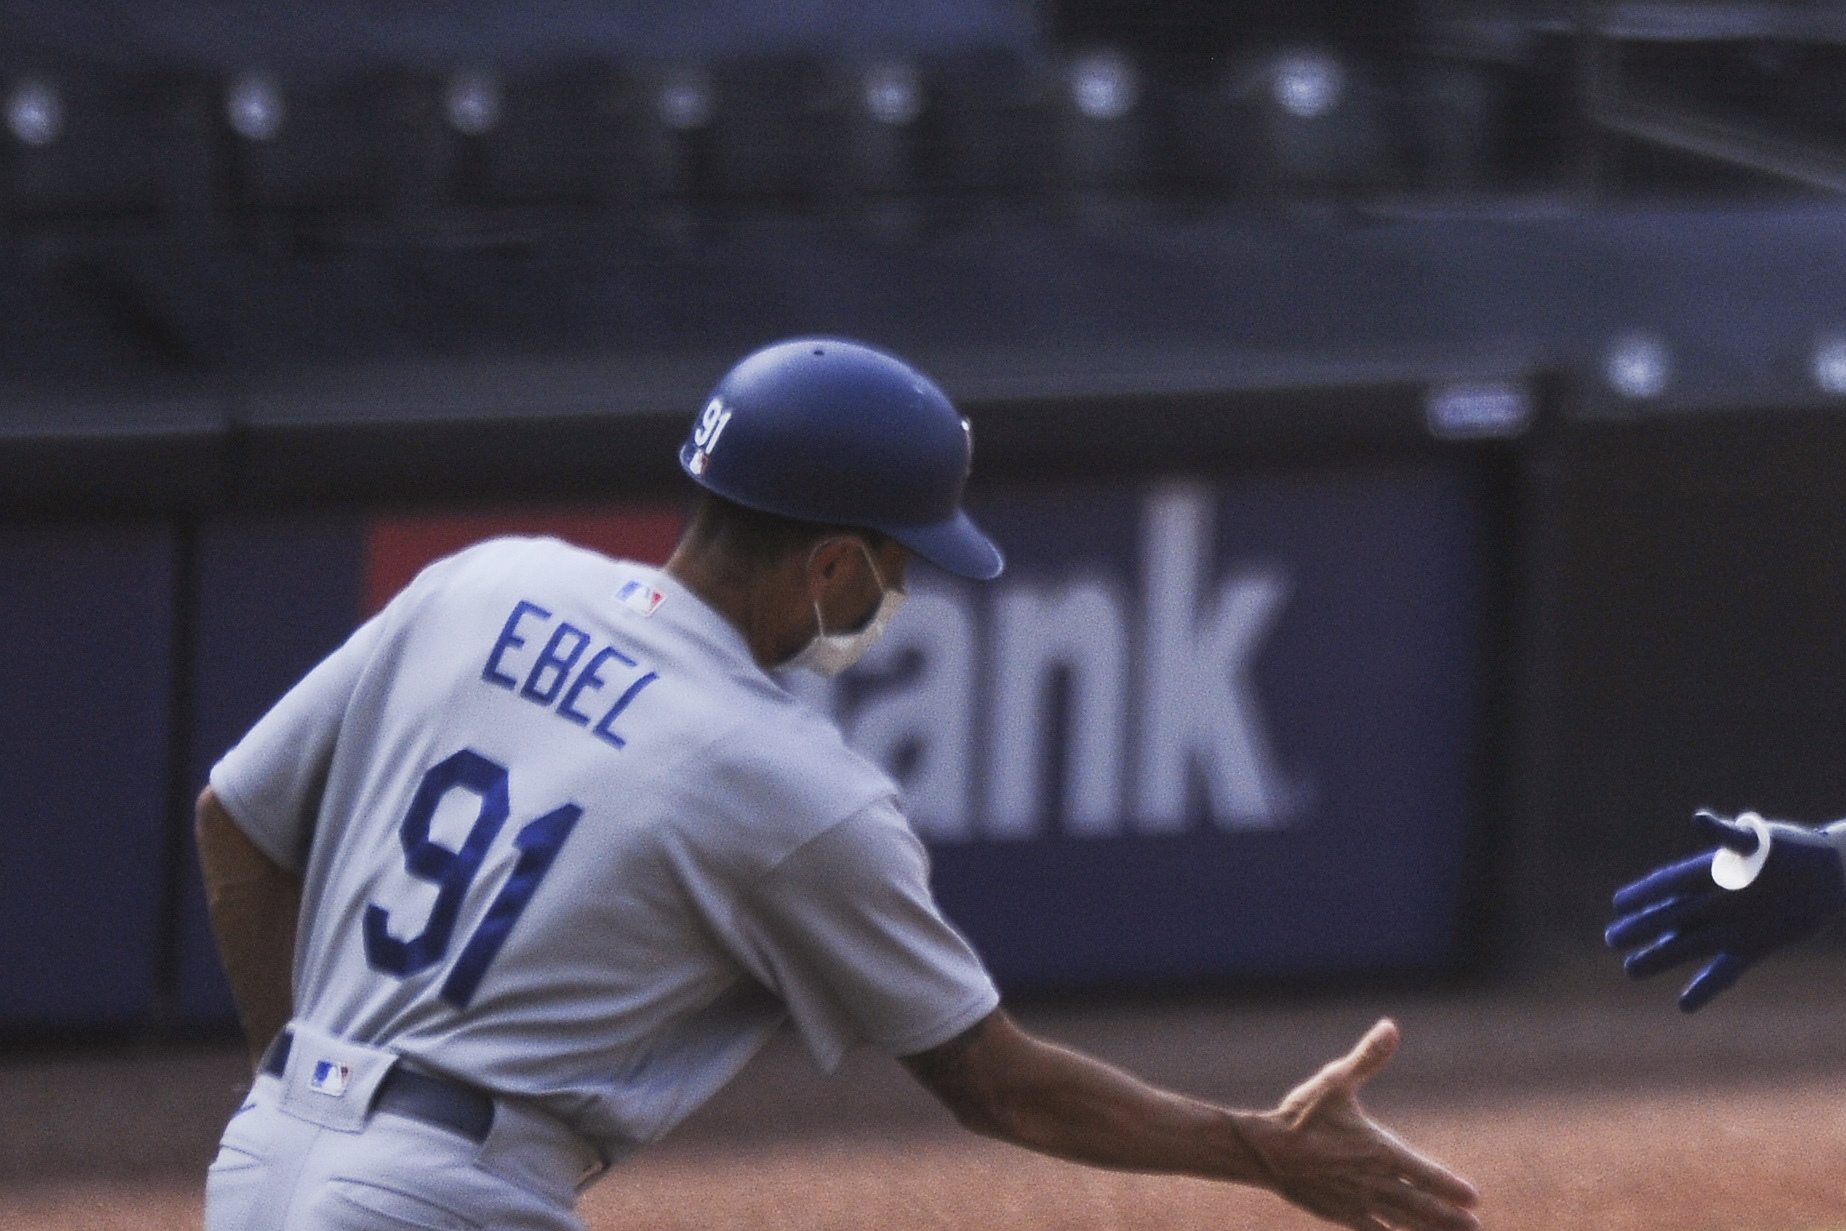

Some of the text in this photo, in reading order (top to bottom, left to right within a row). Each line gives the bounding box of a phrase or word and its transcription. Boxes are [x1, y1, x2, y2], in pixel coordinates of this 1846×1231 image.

[694, 398, 732, 455] 91
[481, 599, 660, 751] EBEL
[362, 748, 584, 1013] 91
